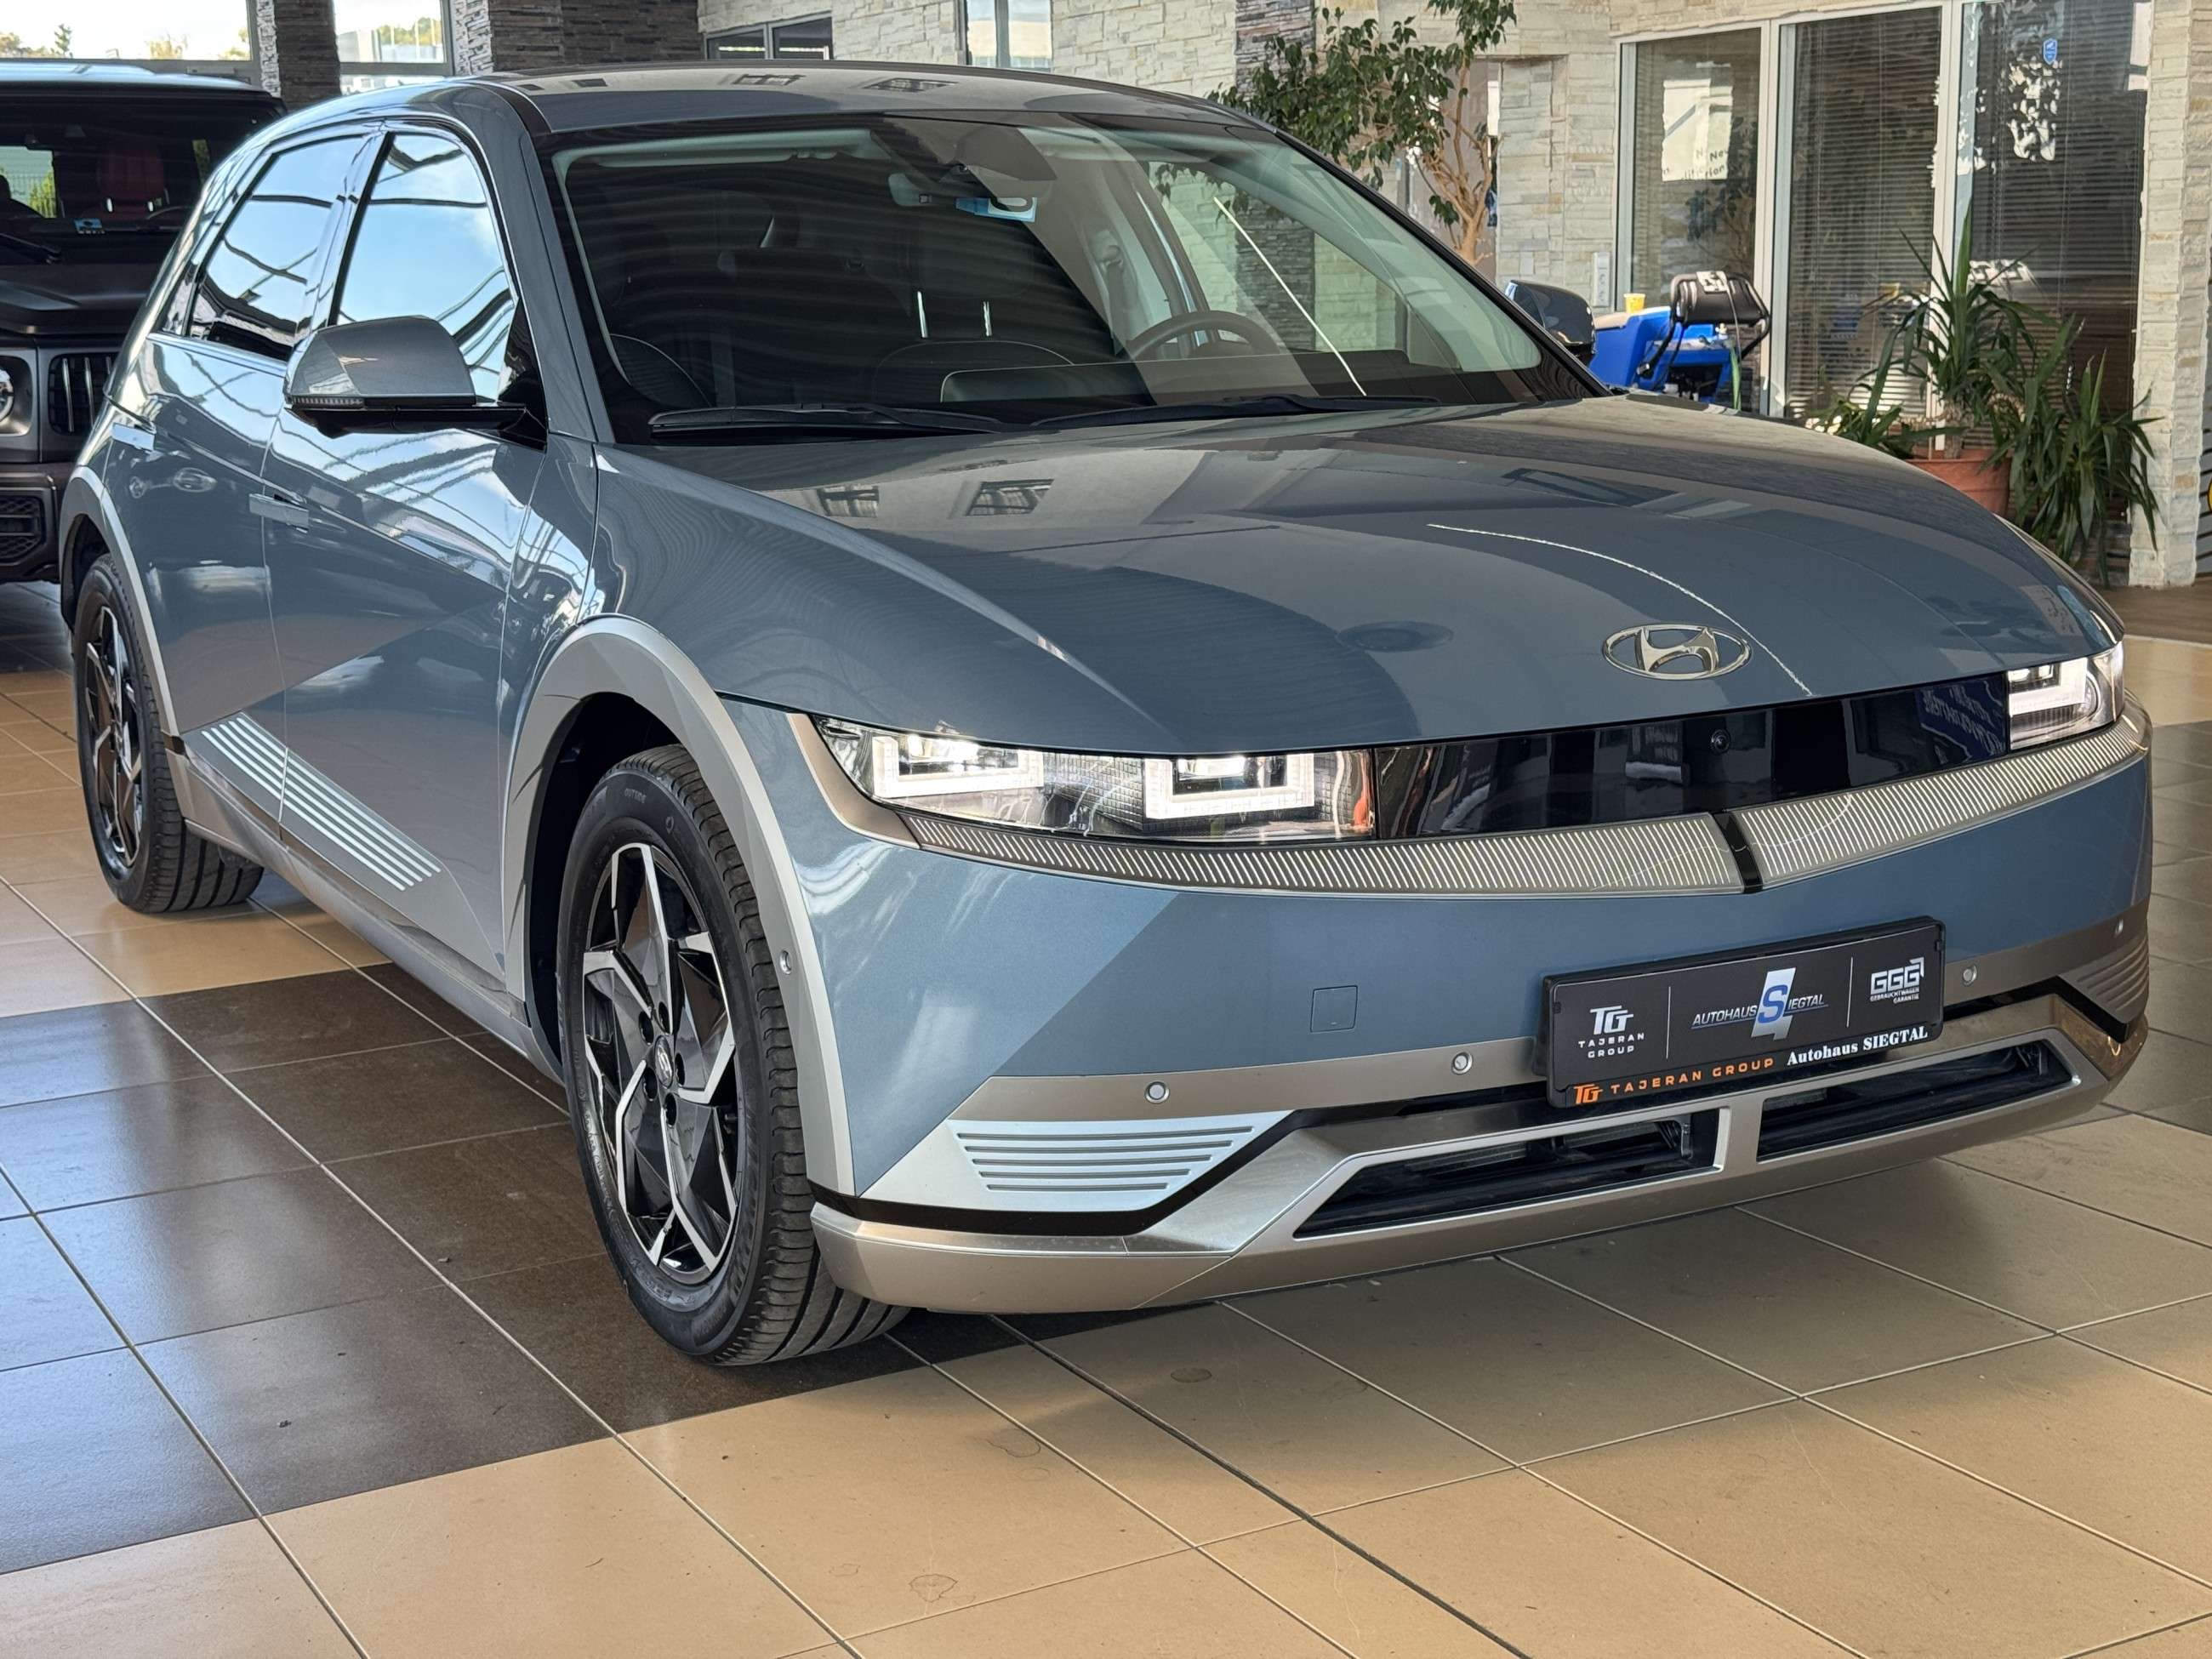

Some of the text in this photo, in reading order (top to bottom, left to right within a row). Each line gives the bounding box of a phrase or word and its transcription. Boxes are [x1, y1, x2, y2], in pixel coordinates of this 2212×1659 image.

[1871, 963, 1920, 995] GGG
[1893, 993, 1919, 1004] GARANTIE
[1692, 1005, 1758, 1026] AUTOHAUS
[1578, 1033, 1645, 1048] TAJERAN
[1588, 1046, 1634, 1058] GROUP
[1611, 1070, 1702, 1094] TAJERAN
[1712, 1058, 1774, 1077] GROUP
[1787, 1044, 1858, 1066] Autohaus
[1863, 1026, 1929, 1052] SIEGTAL
